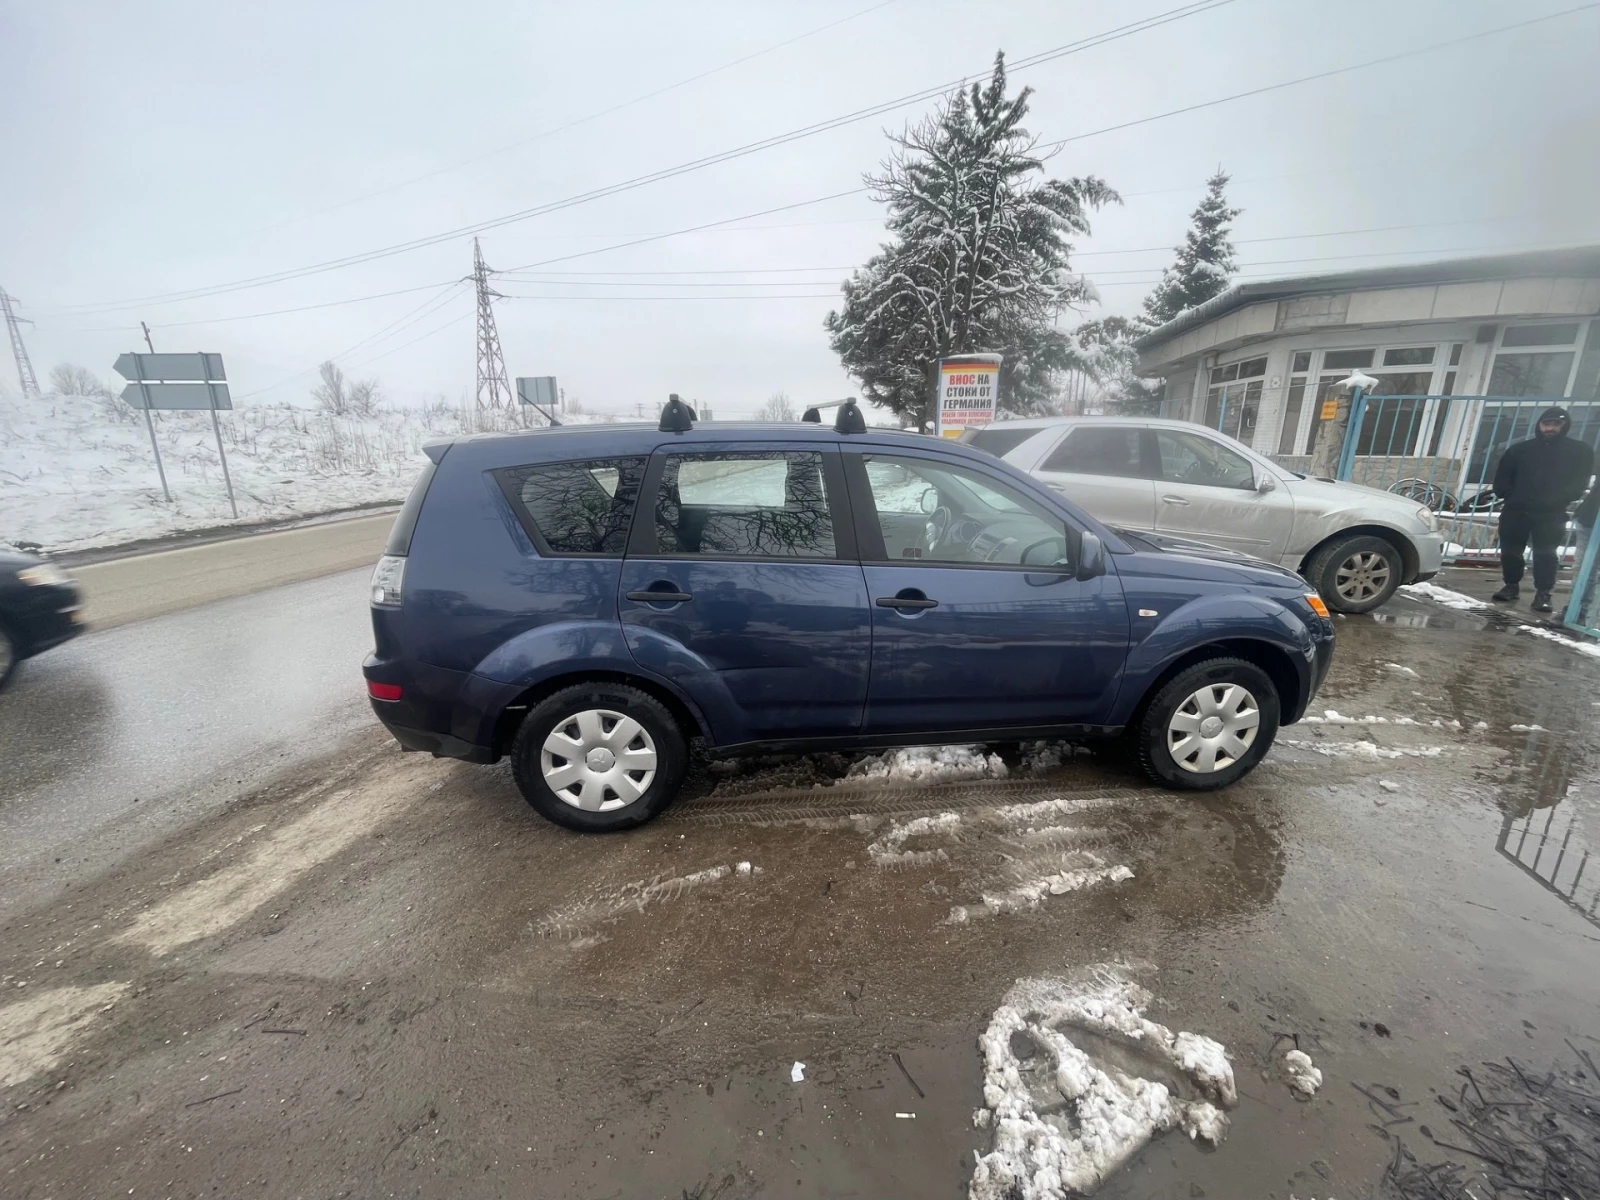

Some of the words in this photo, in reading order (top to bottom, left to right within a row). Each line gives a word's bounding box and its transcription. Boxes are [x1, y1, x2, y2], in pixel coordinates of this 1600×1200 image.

[950, 374, 976, 386] ВНОС
[977, 374, 990, 384] НА
[946, 386, 978, 398] СТОКИ
[979, 386, 991, 397] ОТ
[944, 398, 992, 409] ГЕРМАНИЯ
